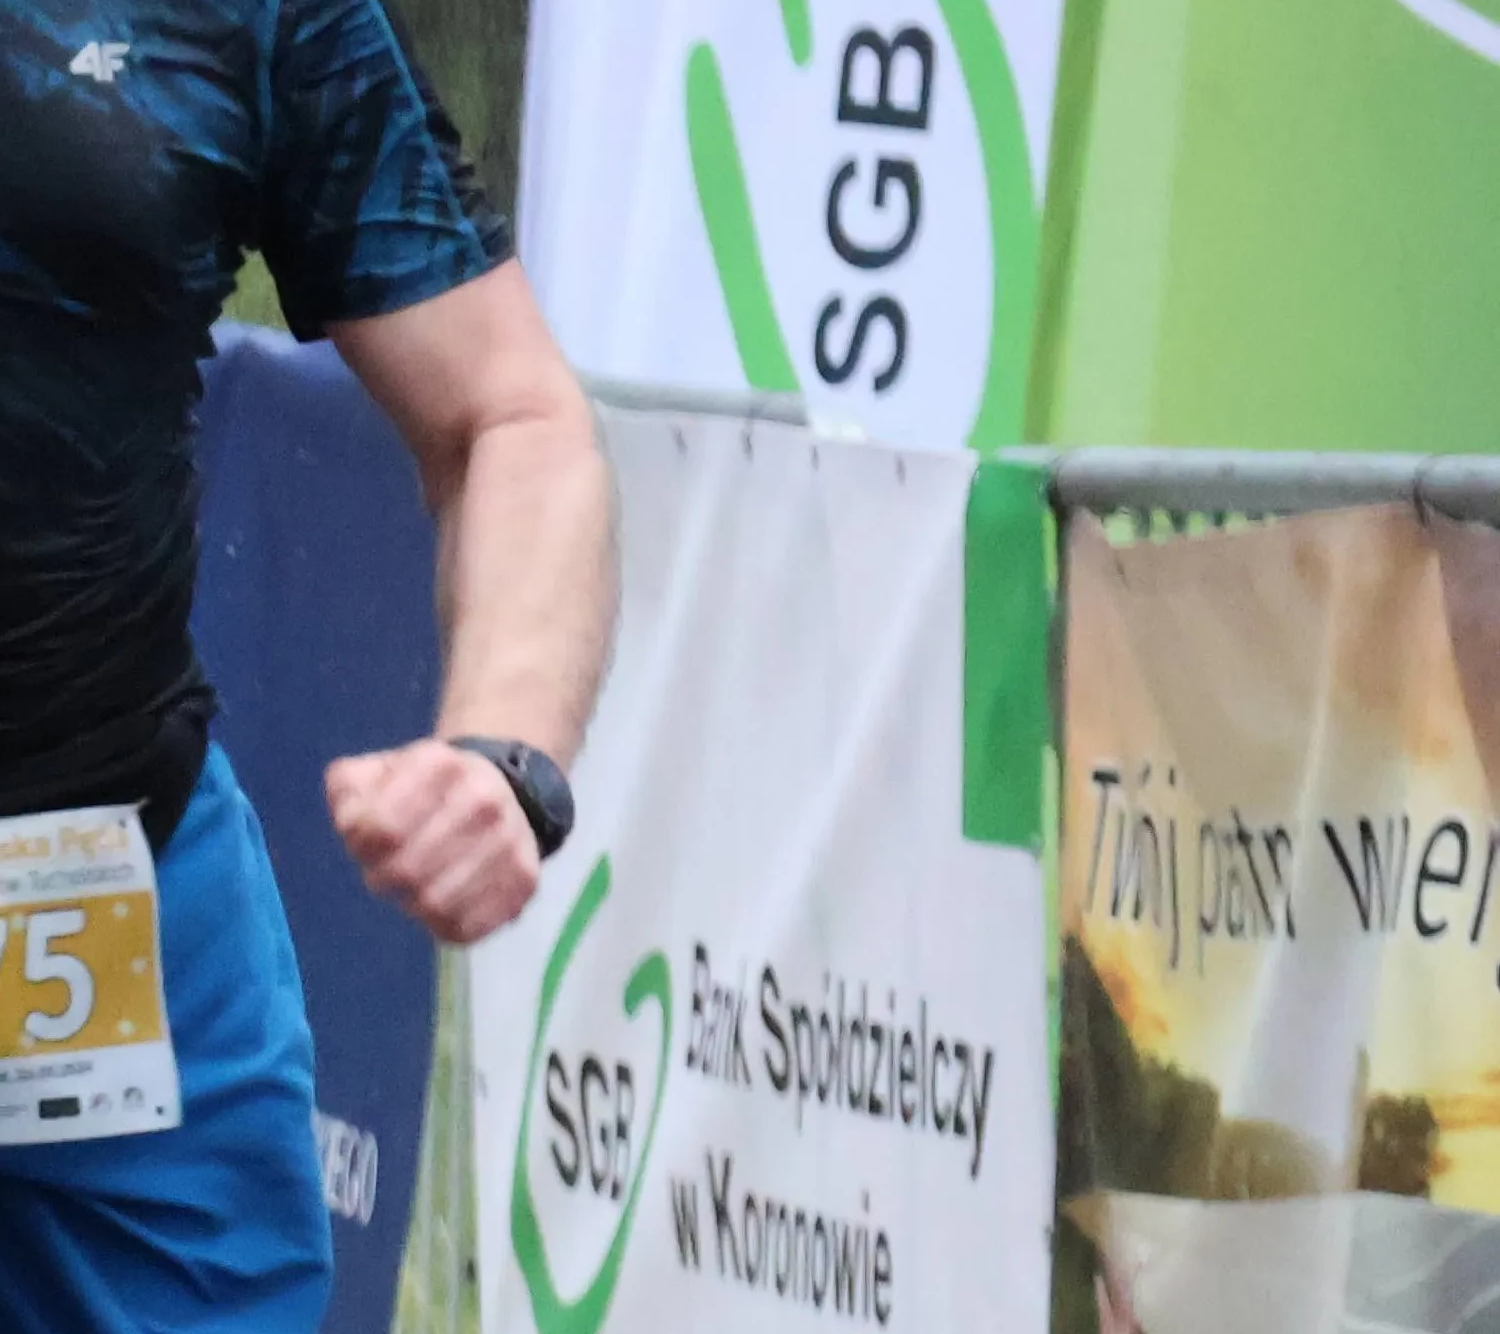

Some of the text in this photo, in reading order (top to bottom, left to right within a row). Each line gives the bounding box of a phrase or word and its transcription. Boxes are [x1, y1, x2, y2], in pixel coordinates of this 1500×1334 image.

[69, 41, 130, 82] 4F
[814, 23, 936, 393] SGB
[310, 1105, 379, 1229] EGO
[545, 1047, 636, 1201] SGB
[706, 1145, 895, 1330] Koronowie
